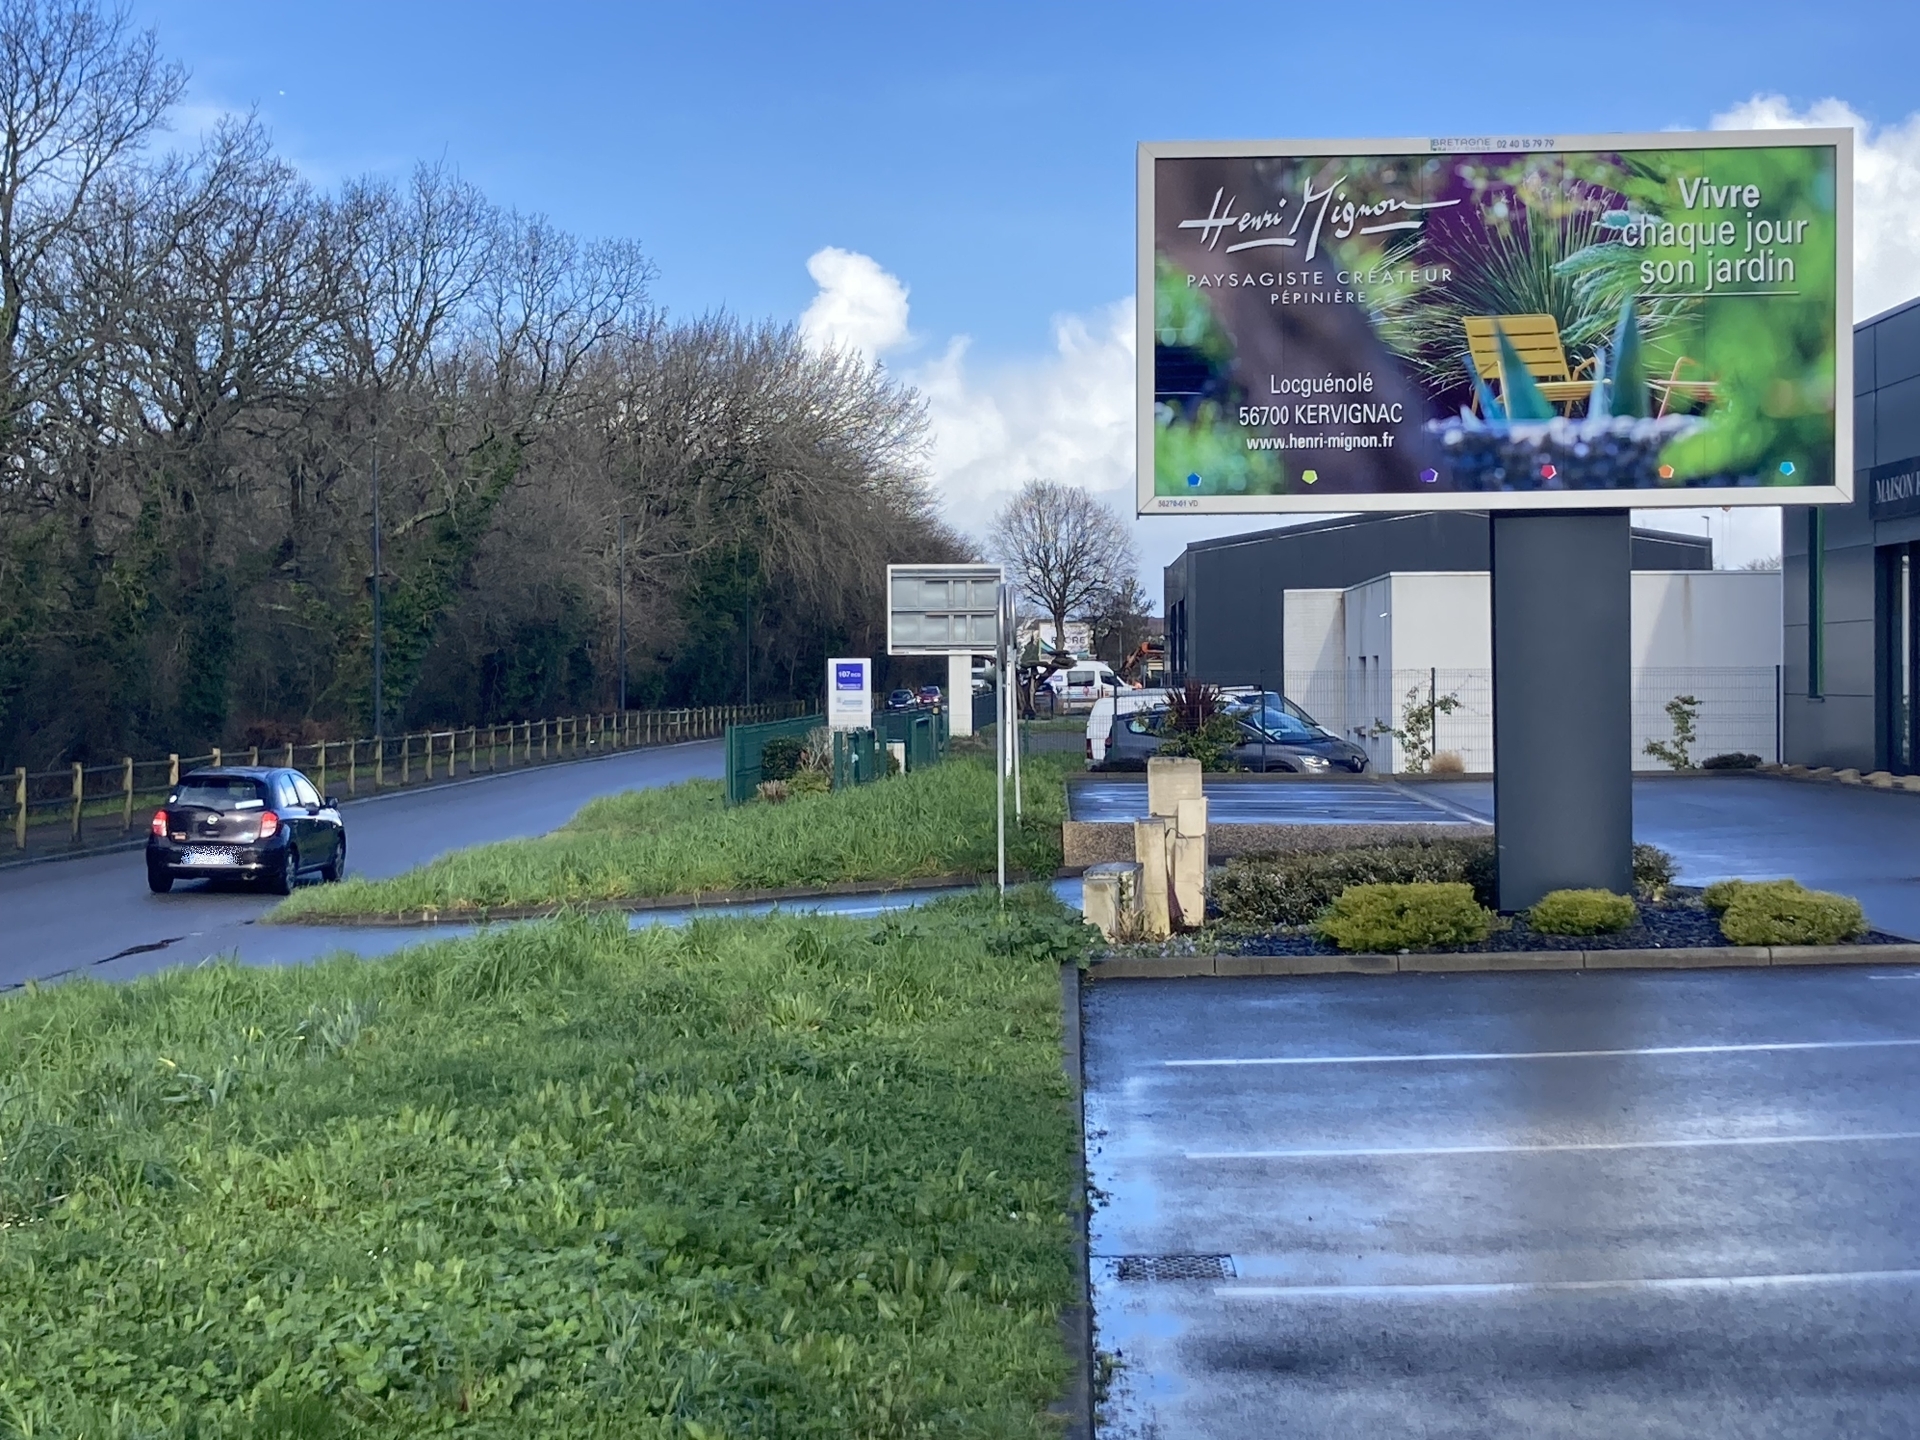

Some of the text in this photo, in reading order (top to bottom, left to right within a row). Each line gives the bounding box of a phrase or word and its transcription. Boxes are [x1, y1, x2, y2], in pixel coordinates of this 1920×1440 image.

[1496, 140, 1507, 149] 02
[1509, 139, 1520, 149] 40
[1522, 139, 1531, 149] 15
[1532, 139, 1543, 149] 79
[1544, 138, 1555, 148] 79
[1678, 177, 1760, 208] Vivre
[1178, 174, 1461, 263] Henri Mignon
[1622, 212, 1809, 253] chaque jour
[1186, 267, 1453, 288] PAYSAGISTE CRÉATEUR
[1639, 249, 1795, 291] son jardin
[1270, 289, 1367, 306] PÉPINIÈRE
[1270, 371, 1374, 399] Locguénolé
[1239, 402, 1403, 427] 56700 KERVIGNAC
[1246, 432, 1395, 452] www.henri-mignon.fr
[1875, 472, 1914, 504] MAISON
